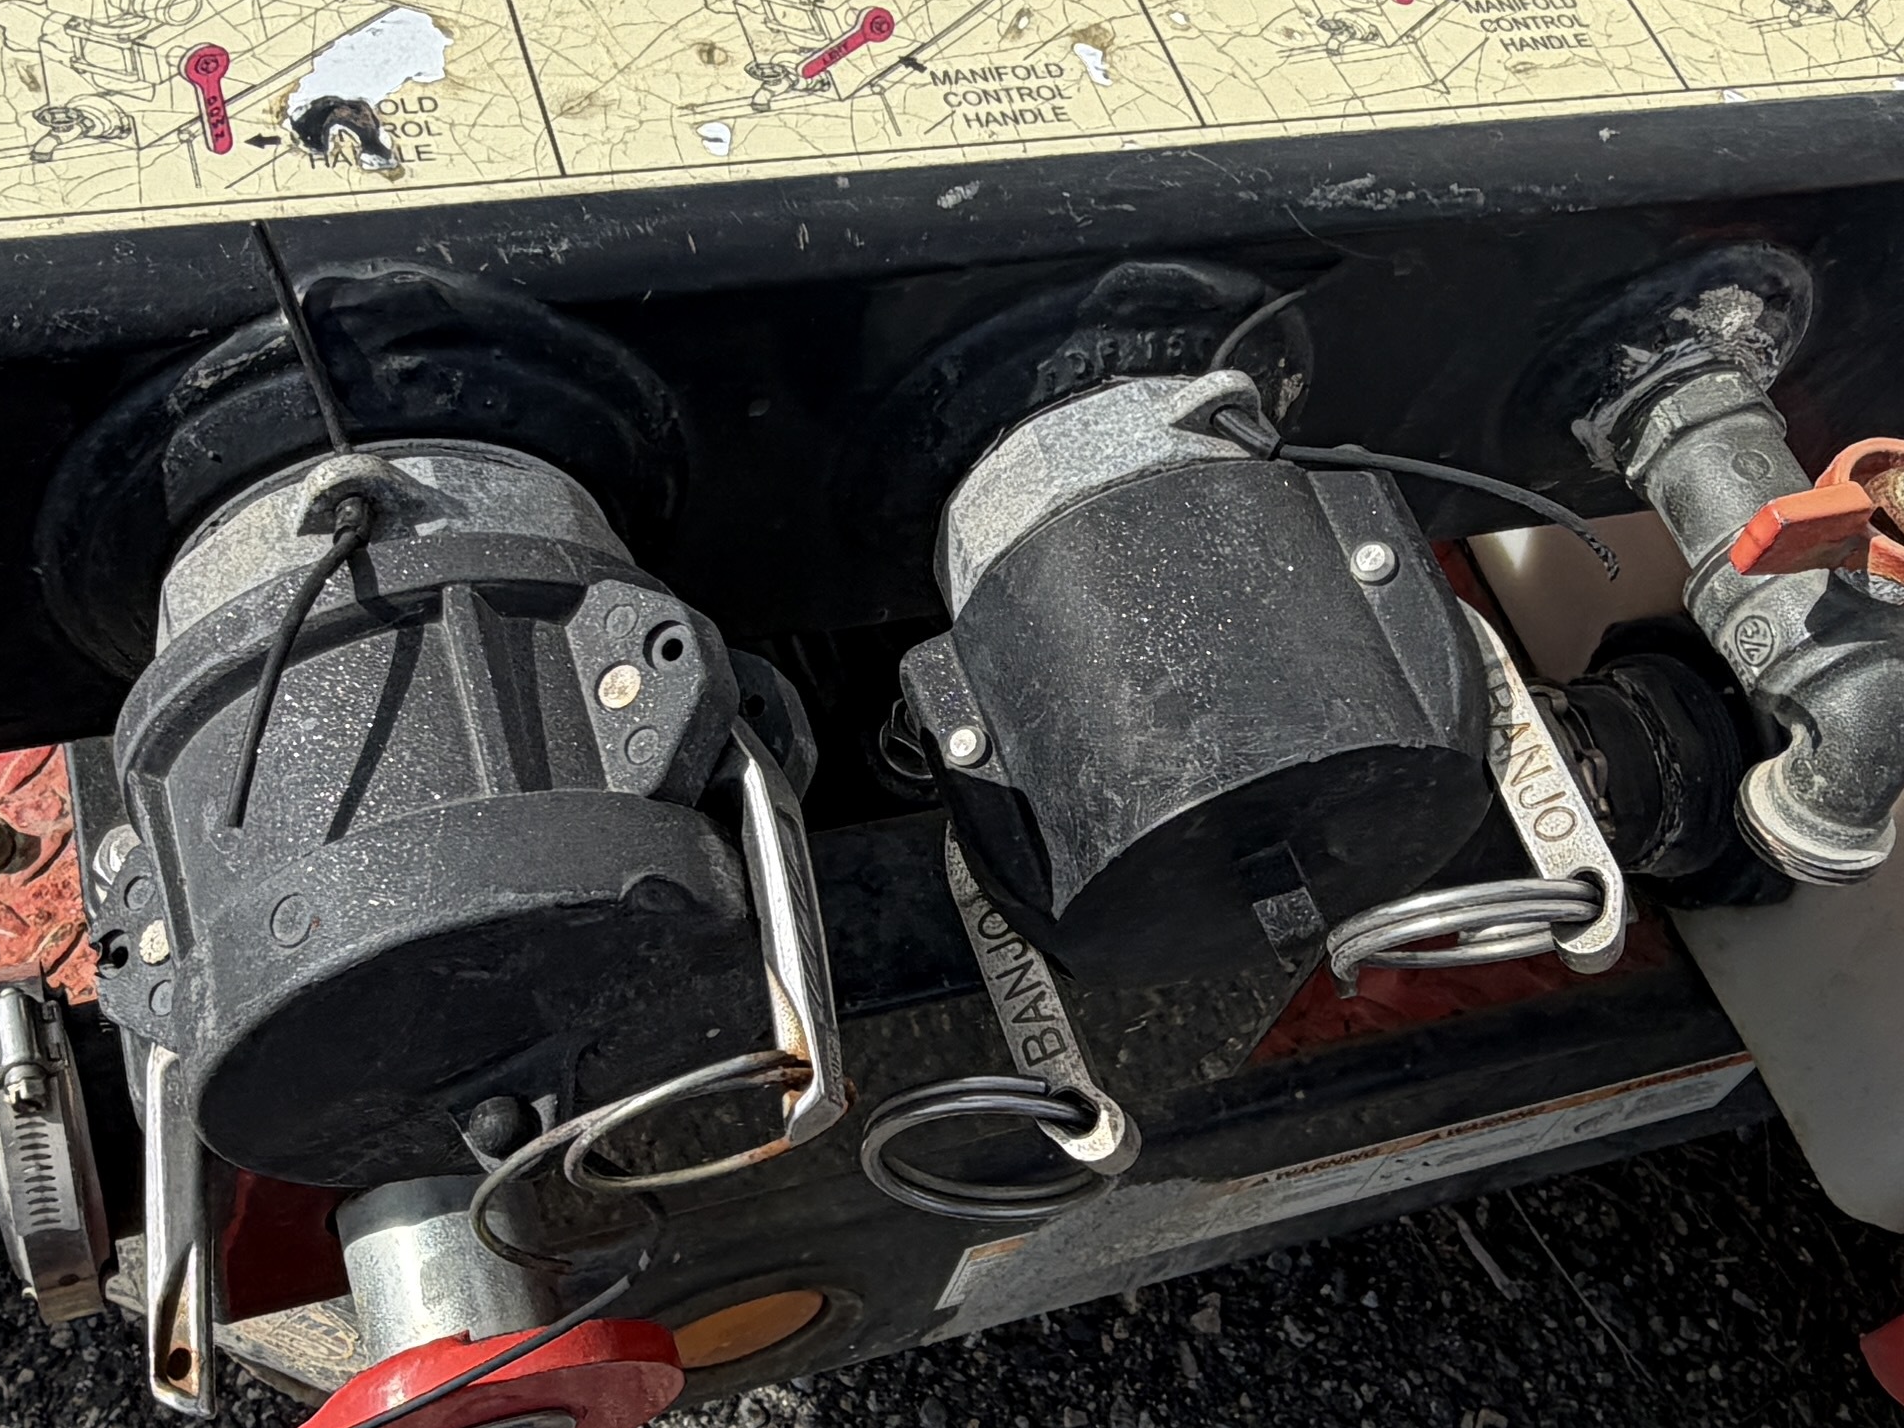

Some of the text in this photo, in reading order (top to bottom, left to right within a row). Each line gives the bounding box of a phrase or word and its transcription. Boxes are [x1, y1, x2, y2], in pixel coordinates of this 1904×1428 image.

[1480, 13, 1589, 34] CONTROL
[1499, 32, 1593, 53] HANDLE
[931, 61, 1065, 87] MANIFOLD
[944, 84, 1073, 109] CONTROL
[963, 106, 1073, 129] HANDLE
[309, 144, 437, 170] HALE
[1486, 678, 1578, 843] BANJO
[977, 908, 1068, 1068] BANJO
